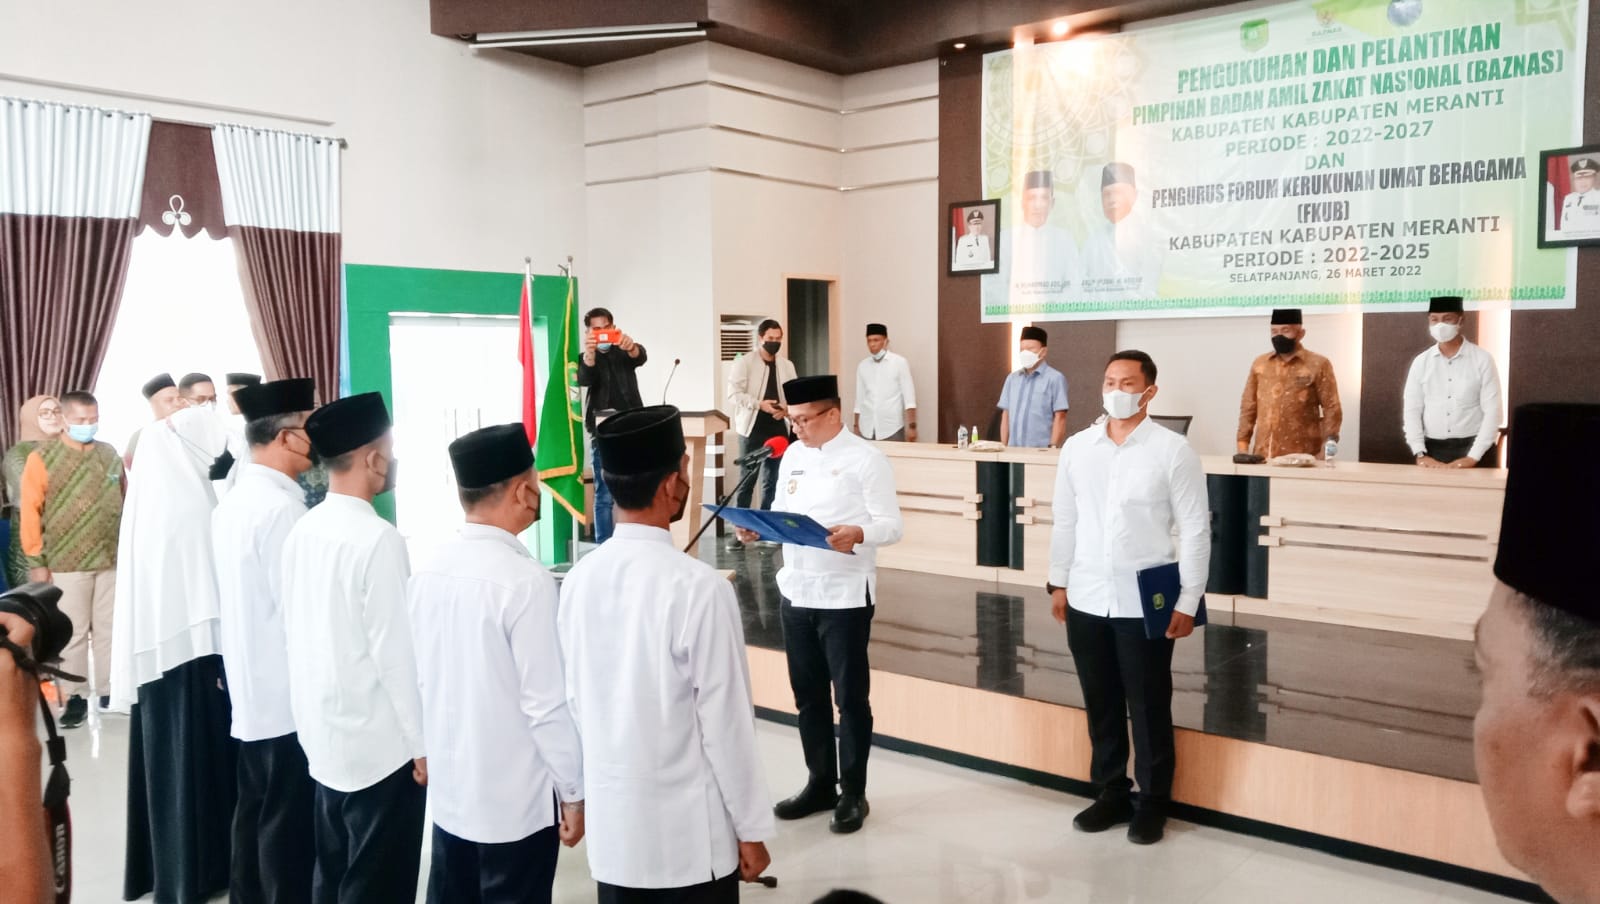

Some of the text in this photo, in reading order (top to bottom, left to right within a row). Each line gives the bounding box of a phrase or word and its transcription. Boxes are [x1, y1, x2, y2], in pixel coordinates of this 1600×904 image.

[1177, 22, 1501, 94] PENGUKUHAN DAN PELANTIKAN
[1132, 49, 1563, 126] PIMPINAN BADAN AMIL ZAKAT NASIONAL (BAZNAS)
[1171, 88, 1505, 142] KABUPATEN KABUPATEN MERANTI
[1225, 134, 1308, 157] PERIODE
[1326, 120, 1434, 147] 2022-2027
[1304, 152, 1345, 171] DAN
[1151, 156, 1527, 209] PENGURUS FORUM KERUKUNAN UMAT BERAGAMA
[1297, 200, 1350, 224] (FKUB)
[1169, 215, 1500, 251] KABUPATEN KABUPATEN MERANTI
[1223, 251, 1304, 268] PERIODE
[1323, 243, 1430, 263] 2022-2025
[1229, 265, 1422, 283] SELATPANJANG, 26 MARET 2022
